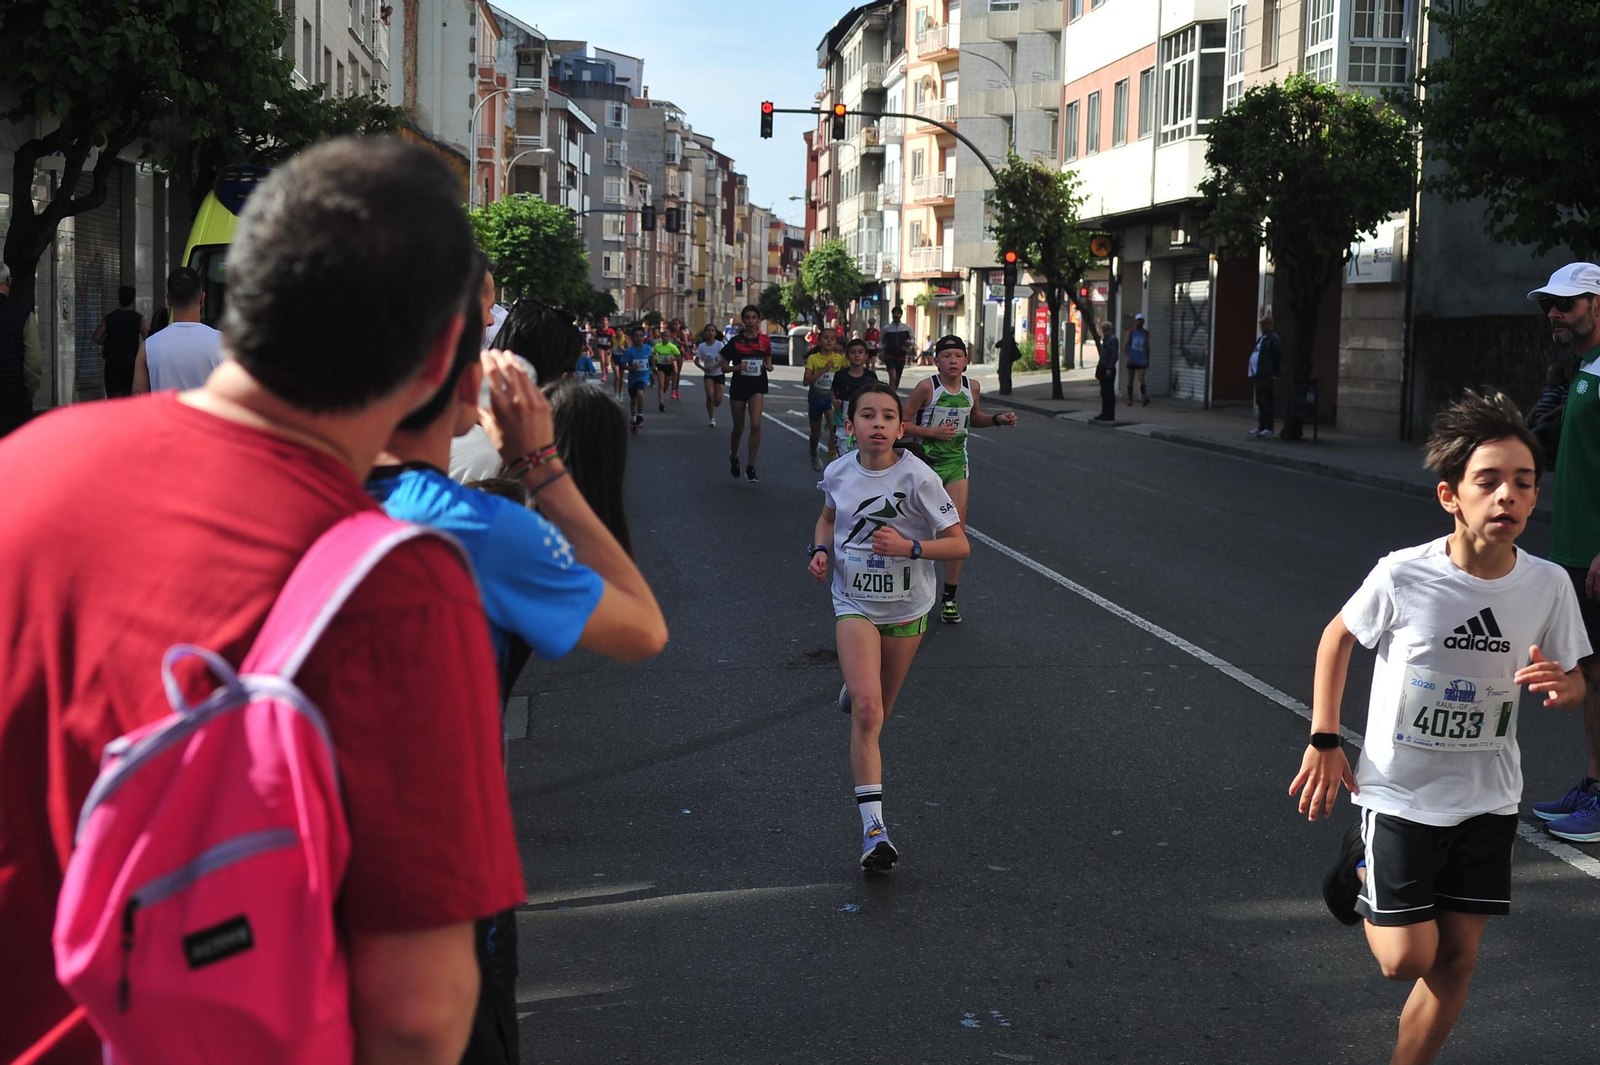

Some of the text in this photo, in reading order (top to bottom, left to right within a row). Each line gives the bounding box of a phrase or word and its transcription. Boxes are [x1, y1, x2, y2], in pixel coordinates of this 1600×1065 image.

[852, 572, 893, 593] 4206
[1444, 634, 1511, 653] adidas
[1411, 678, 1436, 691] 2026
[1412, 705, 1485, 739] 4033
